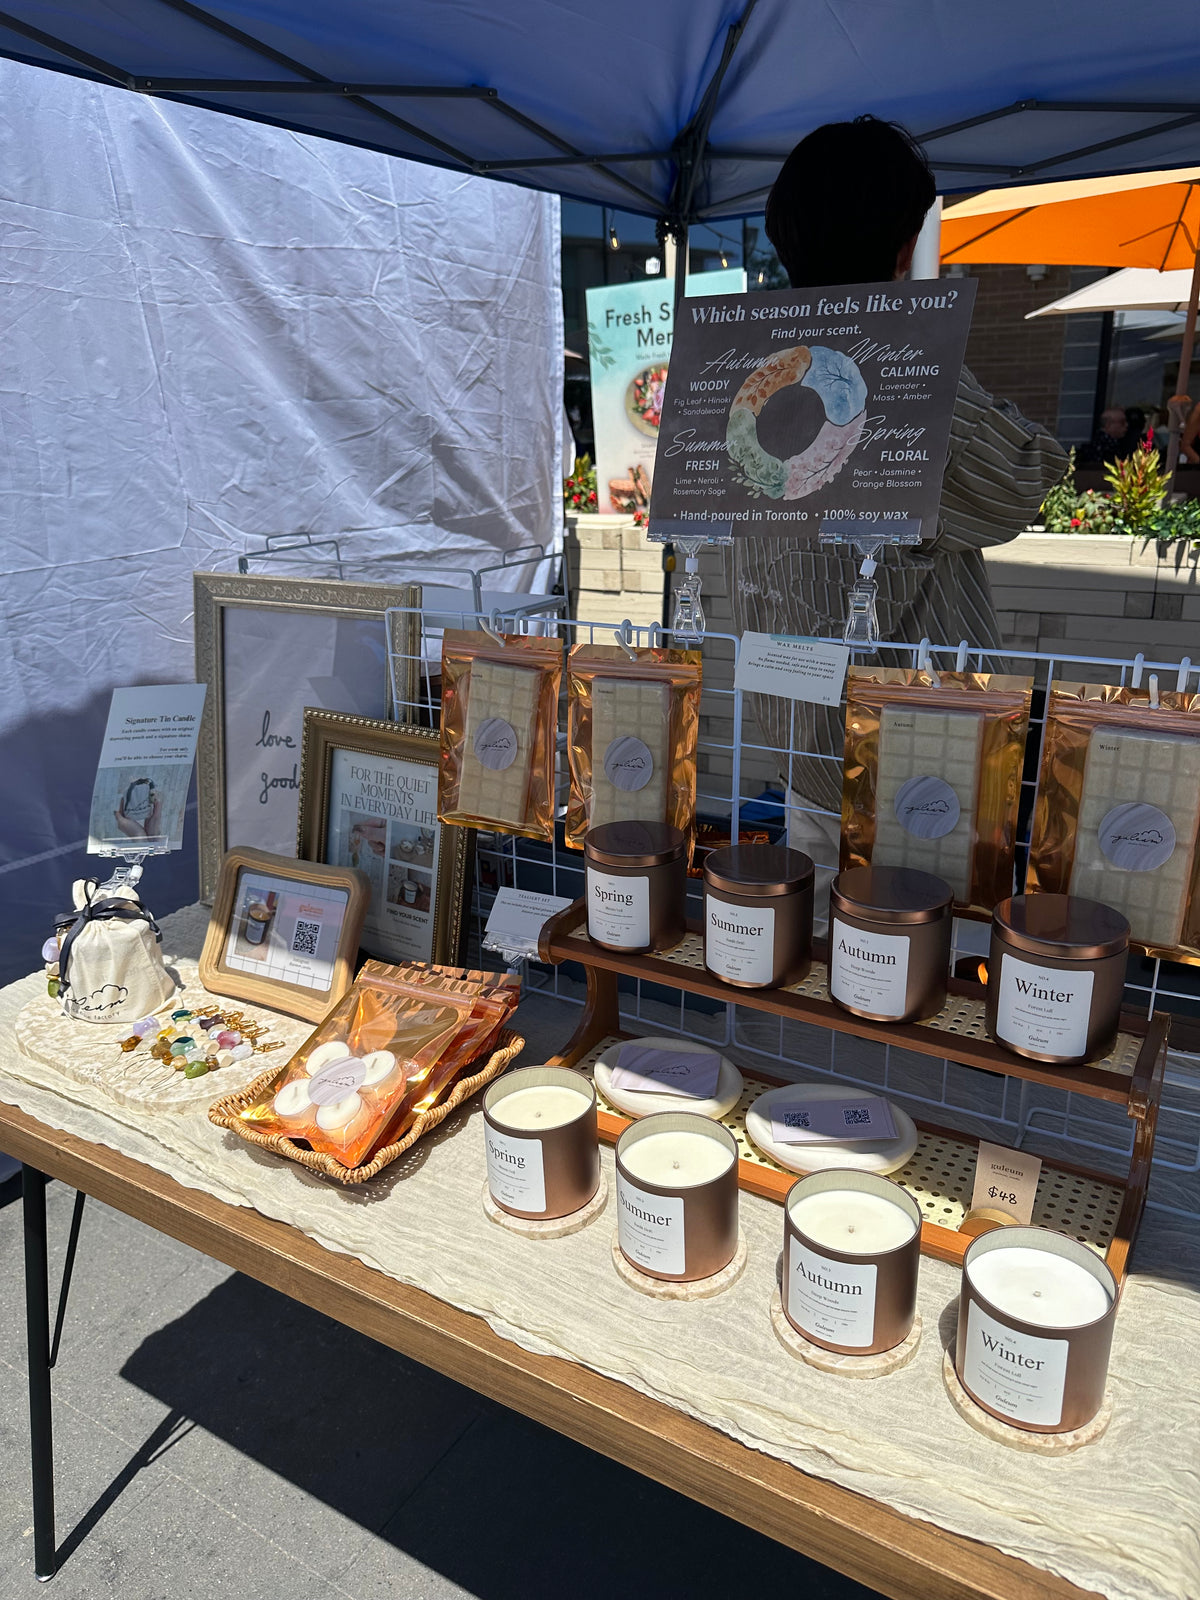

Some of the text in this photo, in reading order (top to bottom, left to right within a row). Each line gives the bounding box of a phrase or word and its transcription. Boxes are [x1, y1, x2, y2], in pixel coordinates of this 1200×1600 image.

[605, 305, 652, 328] Fresh
[691, 305, 746, 324] Which
[750, 303, 811, 321] season
[816, 296, 860, 316] feels
[865, 294, 903, 313] like
[907, 290, 958, 315] you?
[771, 324, 862, 341] Find your scent.
[847, 337, 924, 365] Winter
[699, 348, 778, 375] Autumn
[880, 365, 940, 378] CALMING
[690, 380, 730, 392] WOODY
[880, 382, 920, 391] Lavender
[673, 396, 731, 408] Fig Leaf Hinoki
[872, 392, 932, 402] Moss Amber
[682, 407, 726, 416] Sandalwood
[664, 428, 738, 457] Summer
[847, 415, 926, 451] Spring
[685, 459, 720, 471] FRESH
[880, 450, 929, 462] FLORAL
[675, 477, 719, 485] Lime Neroli
[853, 467, 916, 477] Pear Jasmine
[673, 487, 727, 497] Rosemary Sage
[852, 479, 922, 490] Orange Blossom
[680, 509, 808, 523] Hand-poured in Toronto
[822, 509, 909, 523] 100% soy wax
[777, 641, 814, 652] WAX MELTS
[125, 717, 158, 725] Signature
[256, 710, 296, 748] love
[351, 766, 431, 794] FOR THE QUIET
[360, 783, 414, 806] MOMENTS
[341, 793, 437, 826] IN EVERYDAY LIFE
[595, 885, 633, 906] Spring
[711, 912, 764, 937] Summer
[838, 938, 896, 965] Autumn
[1014, 976, 1074, 1003] Winter
[489, 1140, 526, 1169] Spring
[990, 1163, 1024, 1177] guleum
[988, 1186, 1018, 1205] $48
[620, 1190, 672, 1226] Summer
[796, 1261, 863, 1296] Autumn
[981, 1330, 1045, 1370] Winter
